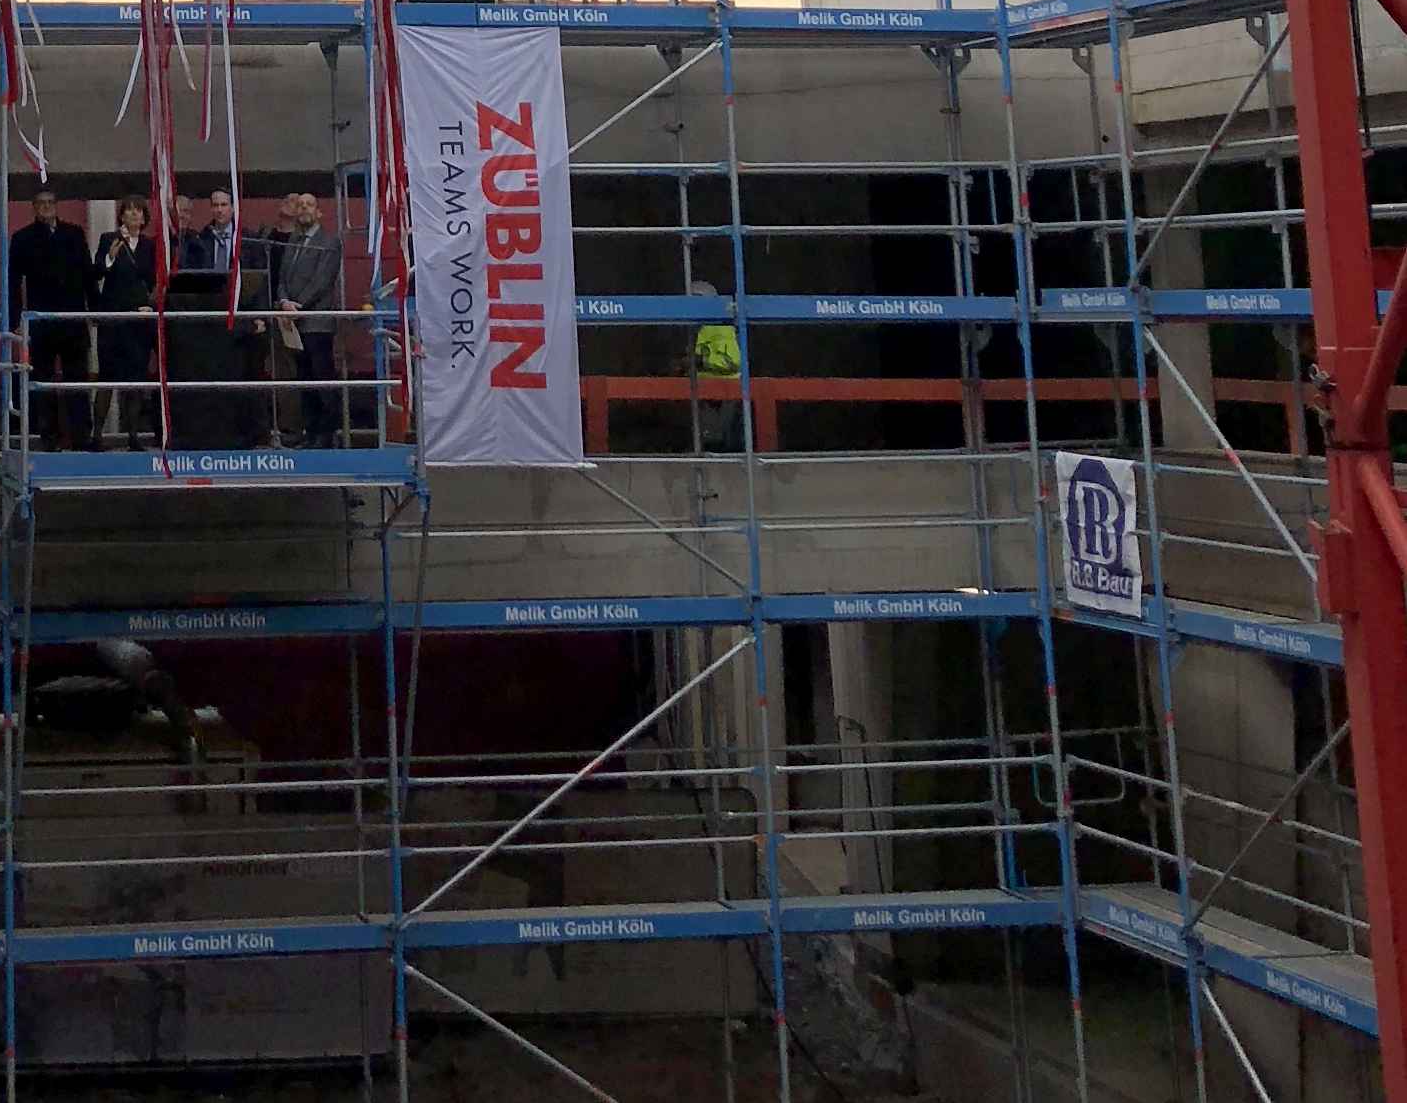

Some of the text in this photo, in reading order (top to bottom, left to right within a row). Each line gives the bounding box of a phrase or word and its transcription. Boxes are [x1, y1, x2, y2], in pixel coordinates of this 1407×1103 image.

[480, 8, 609, 23] Melik GmbH Köln
[798, 11, 923, 27] Melik GmbH Köln
[439, 121, 475, 369] TEAMS WORK.
[476, 101, 547, 389] ZÜBLIN
[589, 300, 624, 315] Köln
[816, 299, 944, 315] Melik GmbH Köln
[200, 455, 251, 471] GmbH
[257, 454, 295, 470] Köln
[505, 604, 638, 621] Melik GmbH Köln
[834, 598, 963, 614] Melik GmbH Köln
[129, 612, 265, 631] Melik GmbH Köln
[855, 908, 985, 927] Melik GmbH Köln
[519, 918, 654, 938] Melik GmbH Köln
[135, 933, 274, 953] Melik GmbH Köln
